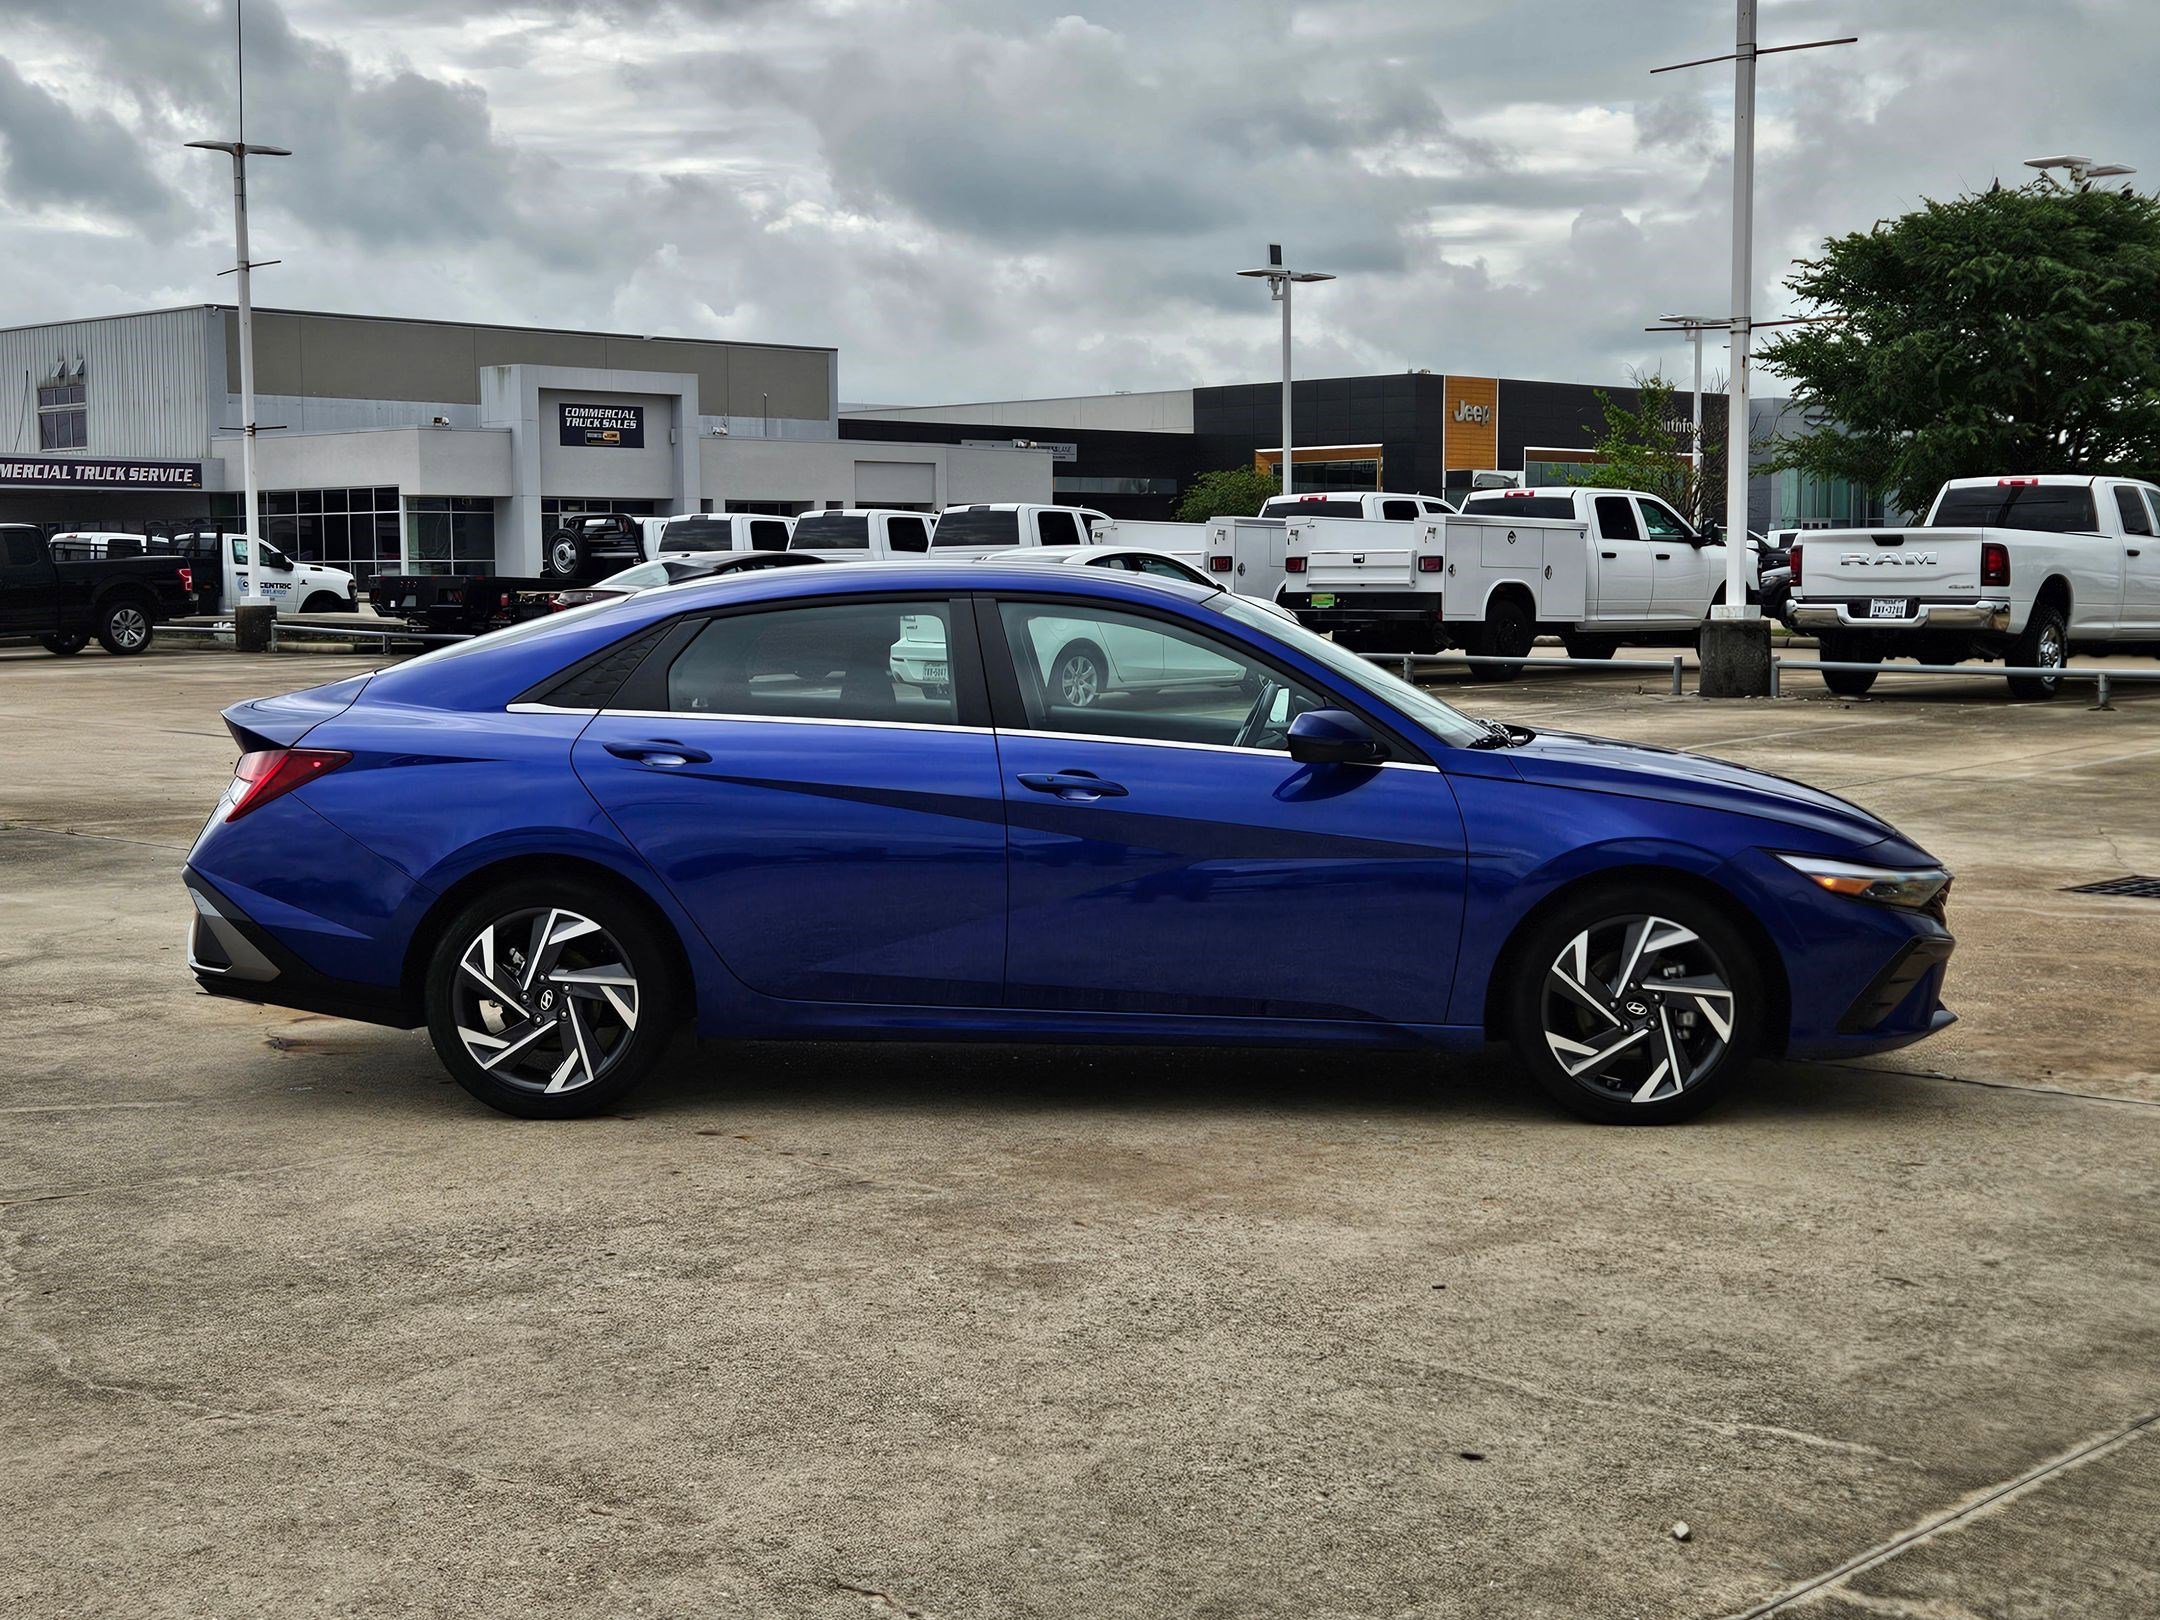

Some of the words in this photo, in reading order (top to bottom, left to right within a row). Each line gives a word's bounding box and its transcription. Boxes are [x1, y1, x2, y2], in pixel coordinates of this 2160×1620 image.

[565, 407, 636, 418] COMMERCIAL
[1453, 400, 1490, 426] Jeep
[565, 417, 600, 427] TRUCK
[602, 419, 637, 428] SALES
[0, 463, 71, 480] MERCIAL
[75, 465, 127, 481] TRUCK
[129, 467, 194, 482] SERVICE
[1840, 552, 1937, 565] RAM
